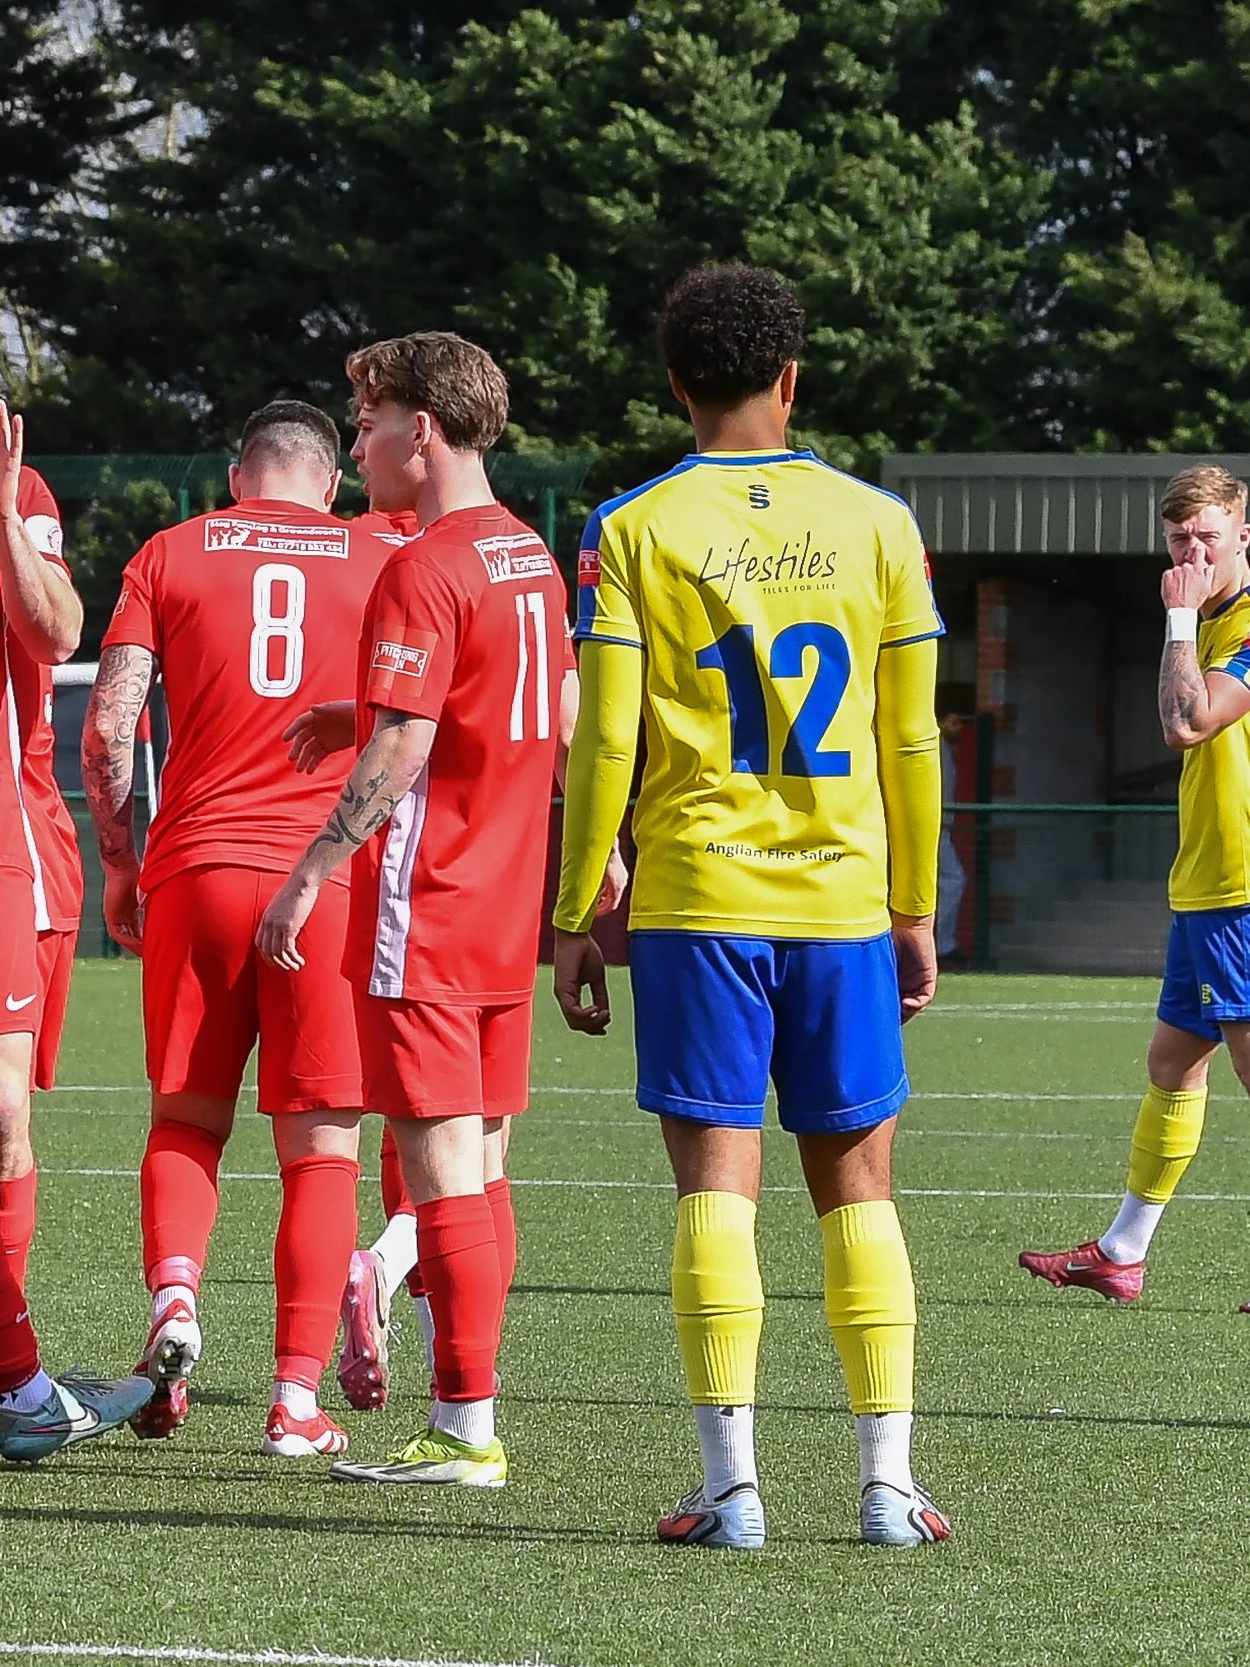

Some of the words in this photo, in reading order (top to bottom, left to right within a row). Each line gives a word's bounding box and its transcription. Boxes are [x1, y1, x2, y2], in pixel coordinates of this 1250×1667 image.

[698, 530, 837, 604] Lifestiles
[763, 586, 789, 595] TILES
[794, 585, 812, 593] FOR
[249, 562, 306, 698] 8
[510, 592, 550, 741] 11
[693, 621, 852, 777] 12
[704, 842, 762, 859] Anglian
[767, 848, 796, 861] Fire
